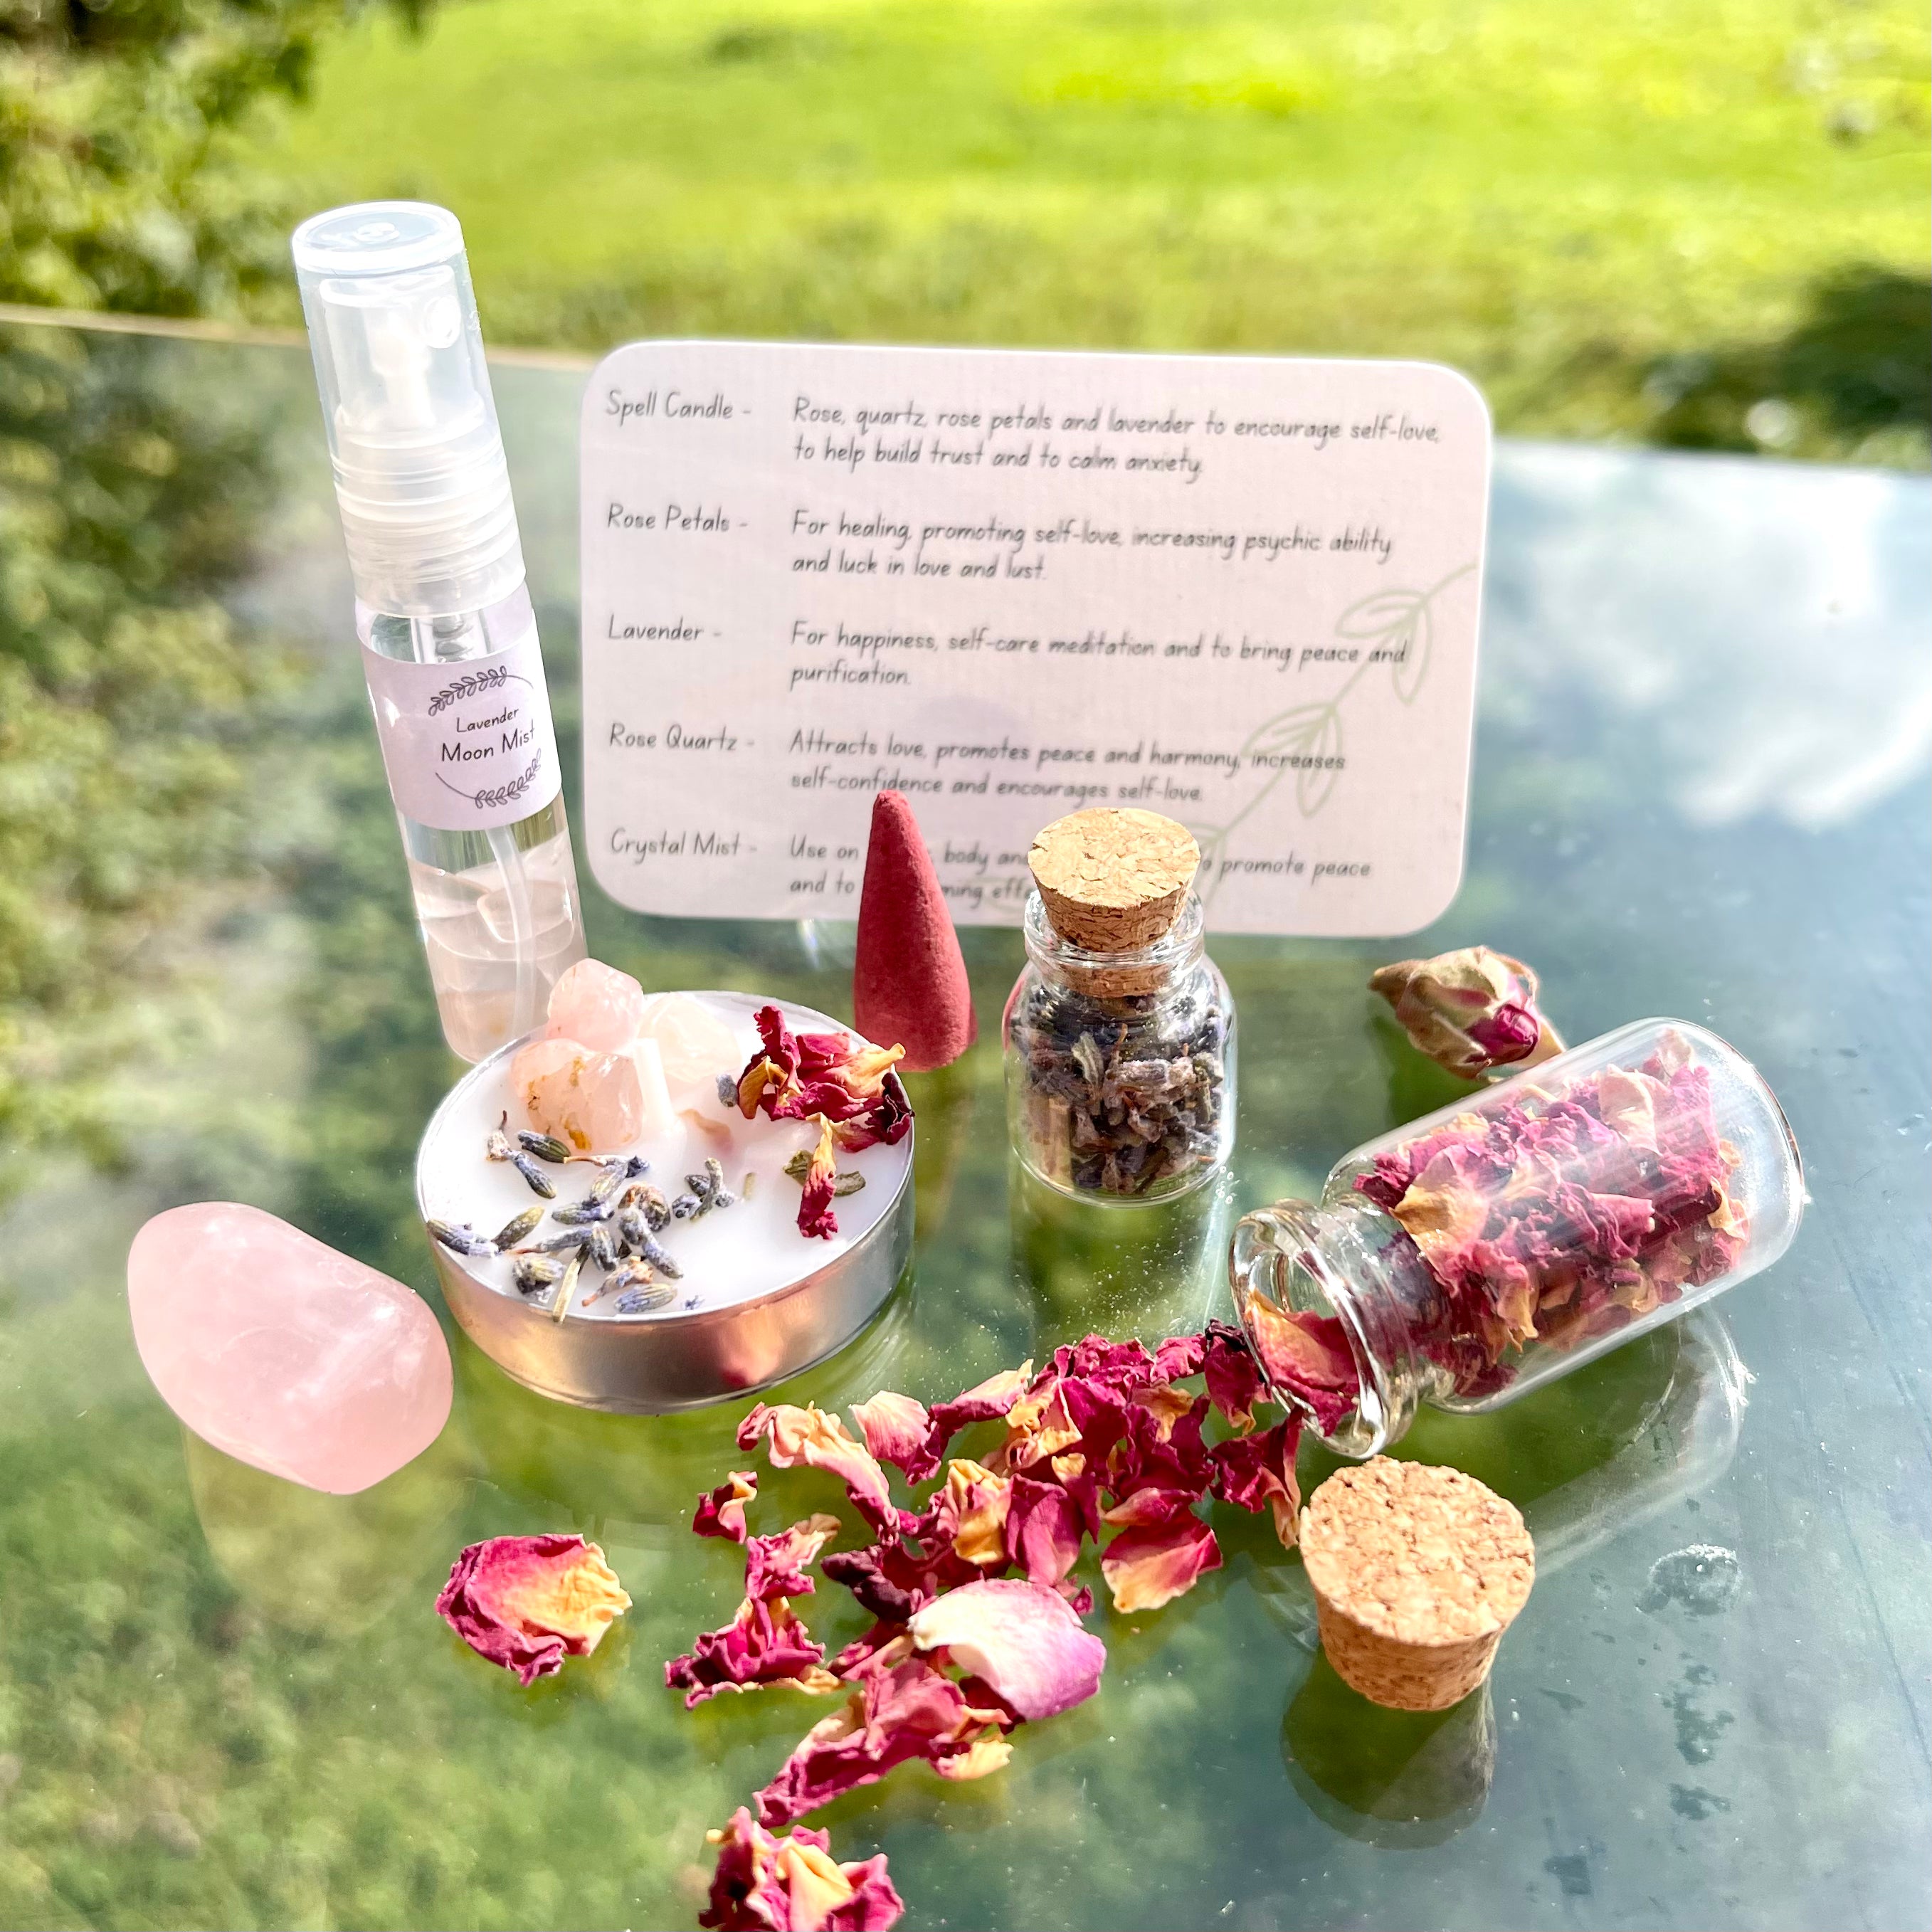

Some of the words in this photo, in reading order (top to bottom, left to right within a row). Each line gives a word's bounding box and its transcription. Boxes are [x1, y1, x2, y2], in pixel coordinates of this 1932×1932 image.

[606, 390, 656, 427] Spell
[665, 391, 733, 419] Candle
[794, 397, 846, 426] Rose,
[938, 412, 981, 428] rose
[990, 403, 1052, 438] petals
[1062, 407, 1098, 432] and
[1108, 406, 1194, 436] lavender
[1205, 408, 1226, 436] to
[1234, 421, 1341, 450] encourage
[794, 437, 815, 460] to
[824, 437, 866, 473] help
[874, 438, 921, 464] build
[930, 438, 983, 466] trust
[993, 443, 1030, 467] and
[1040, 443, 1061, 468] to
[1069, 445, 1117, 470] calm
[607, 503, 655, 529] Rose
[665, 505, 730, 532] Petals
[793, 510, 830, 535] For
[919, 514, 1026, 553] promoting
[1132, 529, 1237, 560] increasing
[1242, 527, 1322, 561] psychic
[1329, 528, 1392, 563] ability
[793, 549, 830, 573] and
[838, 550, 877, 574] luck
[887, 555, 905, 576] in
[914, 551, 951, 577] love
[960, 553, 997, 578] and
[608, 614, 704, 640] Lavender
[791, 621, 829, 645] For
[837, 621, 939, 659] happiness,
[949, 626, 1039, 655] self-care
[1049, 629, 1155, 656] meditation
[1163, 631, 1201, 658] and
[1211, 632, 1231, 658] to
[1240, 634, 1293, 672] bring
[1300, 645, 1359, 672] peace
[1368, 638, 1405, 663] and
[791, 659, 911, 691] purification.
[456, 707, 519, 733] Lavender
[610, 722, 656, 748] Rose
[666, 724, 737, 751] Quartz
[441, 743, 494, 761] Moon
[502, 719, 535, 754] Mist
[788, 728, 877, 756] Attracts
[935, 735, 1030, 767] promotes
[1036, 746, 1095, 769] peace
[1105, 740, 1141, 764] and
[1150, 741, 1241, 778] harmony,
[1251, 750, 1346, 770] increases
[791, 765, 943, 793] self-confidence
[951, 769, 991, 794] and
[997, 779, 1108, 808] encourages
[611, 828, 686, 865] Crystal
[694, 833, 742, 857] Mist
[791, 835, 828, 860] Use
[836, 845, 860, 860] on
[944, 839, 989, 876] body
[998, 847, 1029, 866] an
[1220, 850, 1304, 880] promote
[1311, 862, 1371, 886] peace
[791, 872, 828, 893] and
[835, 872, 855, 894] to
